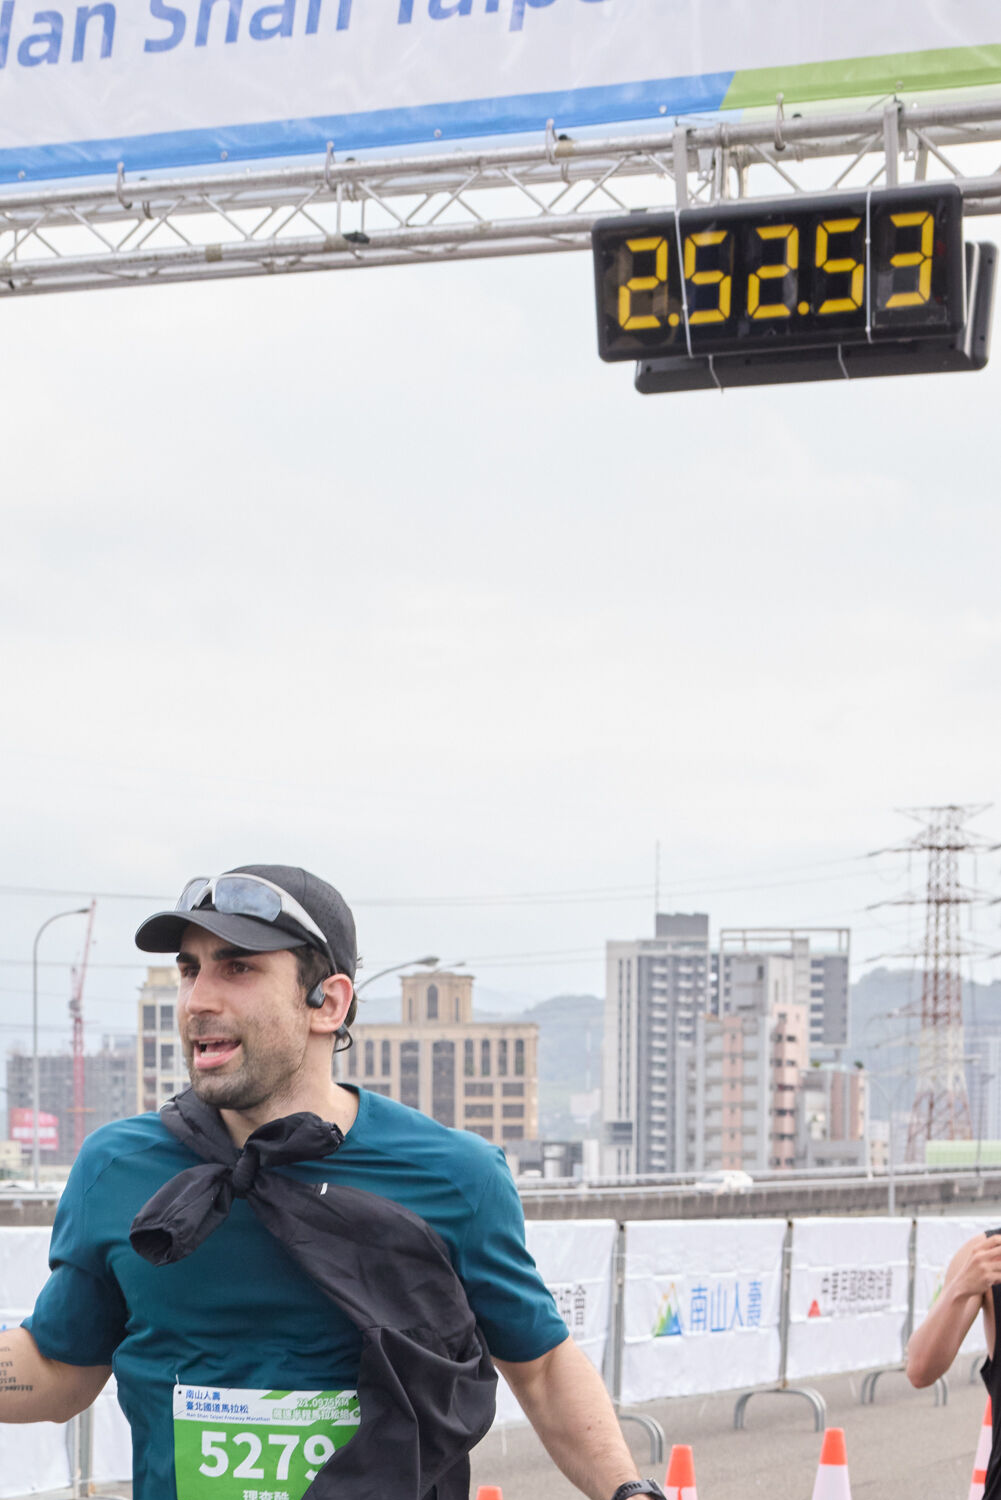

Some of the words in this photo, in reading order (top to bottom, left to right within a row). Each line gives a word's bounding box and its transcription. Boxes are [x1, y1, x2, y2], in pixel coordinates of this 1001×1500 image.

[690, 1280, 762, 1332] 南山人壽
[186, 1389, 220, 1400] 南山人壽
[186, 1401, 248, 1414] 臺北國道馬拉松
[198, 1430, 336, 1481] 5279
